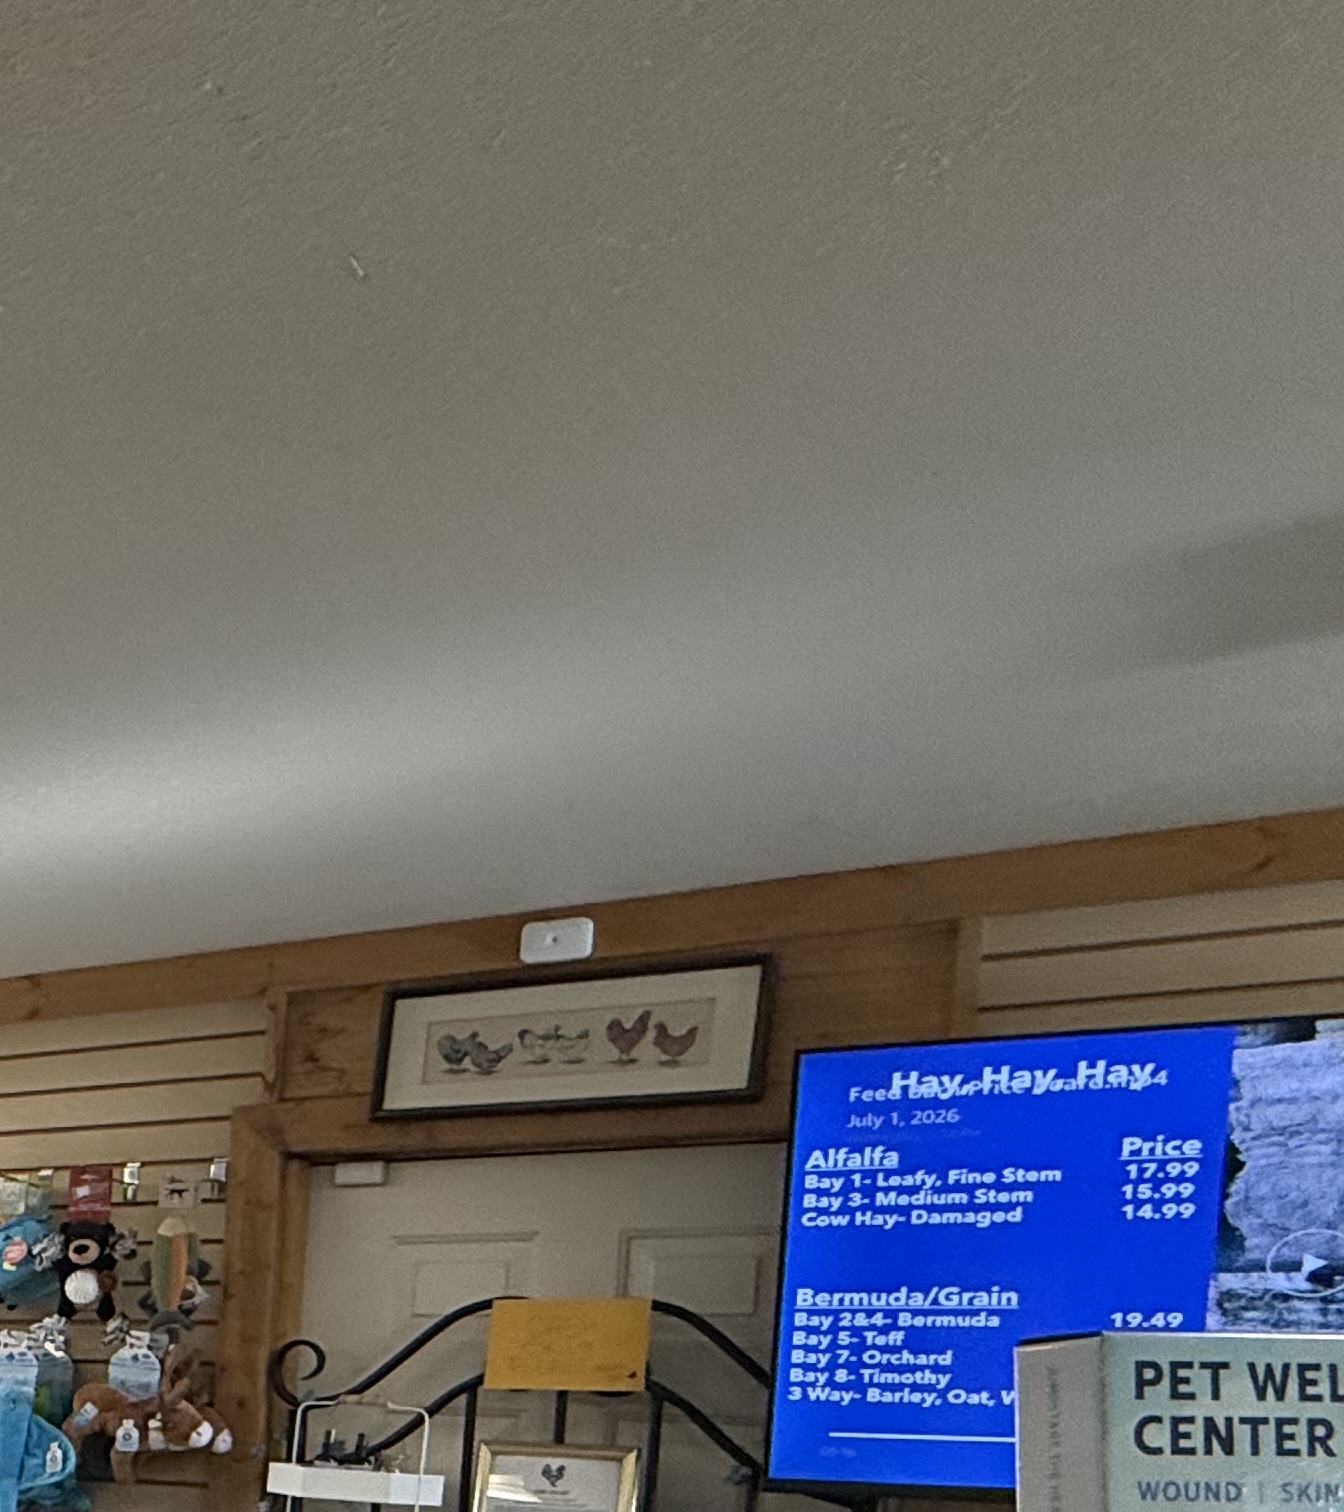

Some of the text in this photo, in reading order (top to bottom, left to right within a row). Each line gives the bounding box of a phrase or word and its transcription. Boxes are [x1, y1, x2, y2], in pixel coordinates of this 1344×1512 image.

[846, 1108, 961, 1130] July 1, 2026
[805, 1145, 900, 1170] Alfalfa
[1120, 1134, 1203, 1159] Price
[804, 1167, 1063, 1193] Bay 1- Leafy, Fine Stem
[1125, 1161, 1201, 1180] 17.99
[802, 1188, 1034, 1212] Bay 3- Medium Stem
[1121, 1182, 1197, 1201] 15.99
[801, 1206, 1024, 1230] Cow Hay- Damaged
[1121, 1202, 1197, 1221] 14.99
[795, 1285, 1020, 1309] Bermuda/Grain
[794, 1311, 834, 1331] Bay
[897, 1311, 1001, 1328] Bermuda
[1110, 1311, 1184, 1329] 19.49
[792, 1330, 906, 1350] Bay 5- Teff
[790, 1349, 954, 1368] Bay 7- Orchard
[788, 1367, 953, 1389] Bay 8- Timothy
[1134, 1361, 1230, 1401] PET
[787, 1386, 803, 1402] 3
[807, 1386, 862, 1406] Way-
[866, 1387, 942, 1408] Barley,
[946, 1388, 996, 1407] Oat,
[1133, 1415, 1338, 1458] CENTER
[1137, 1480, 1243, 1502] WOUND
